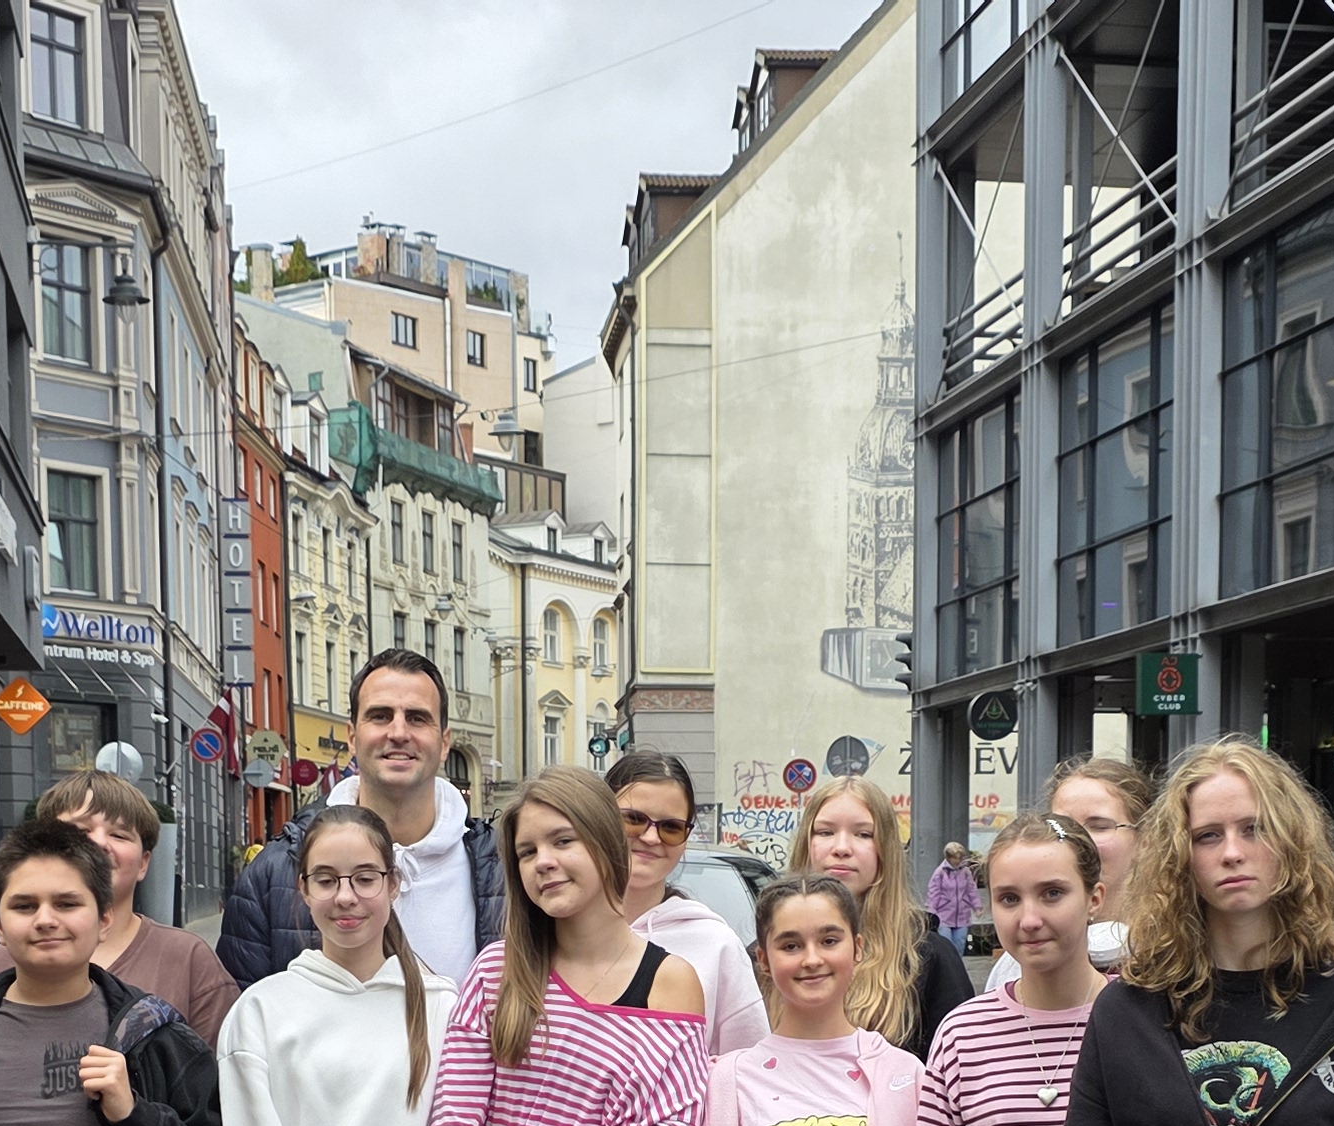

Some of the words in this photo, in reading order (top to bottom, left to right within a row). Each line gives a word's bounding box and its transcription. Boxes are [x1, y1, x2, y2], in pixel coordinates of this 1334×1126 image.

[228, 504, 245, 681] HOTEL
[59, 610, 155, 645] Wellton
[43, 645, 84, 660] ntrum
[87, 646, 118, 662] Hotel
[120, 650, 131, 664] &
[132, 651, 155, 668] Spa
[1153, 694, 1186, 702] CYBER
[1158, 703, 1182, 711] CLUB
[44, 1064, 80, 1094] JUS
